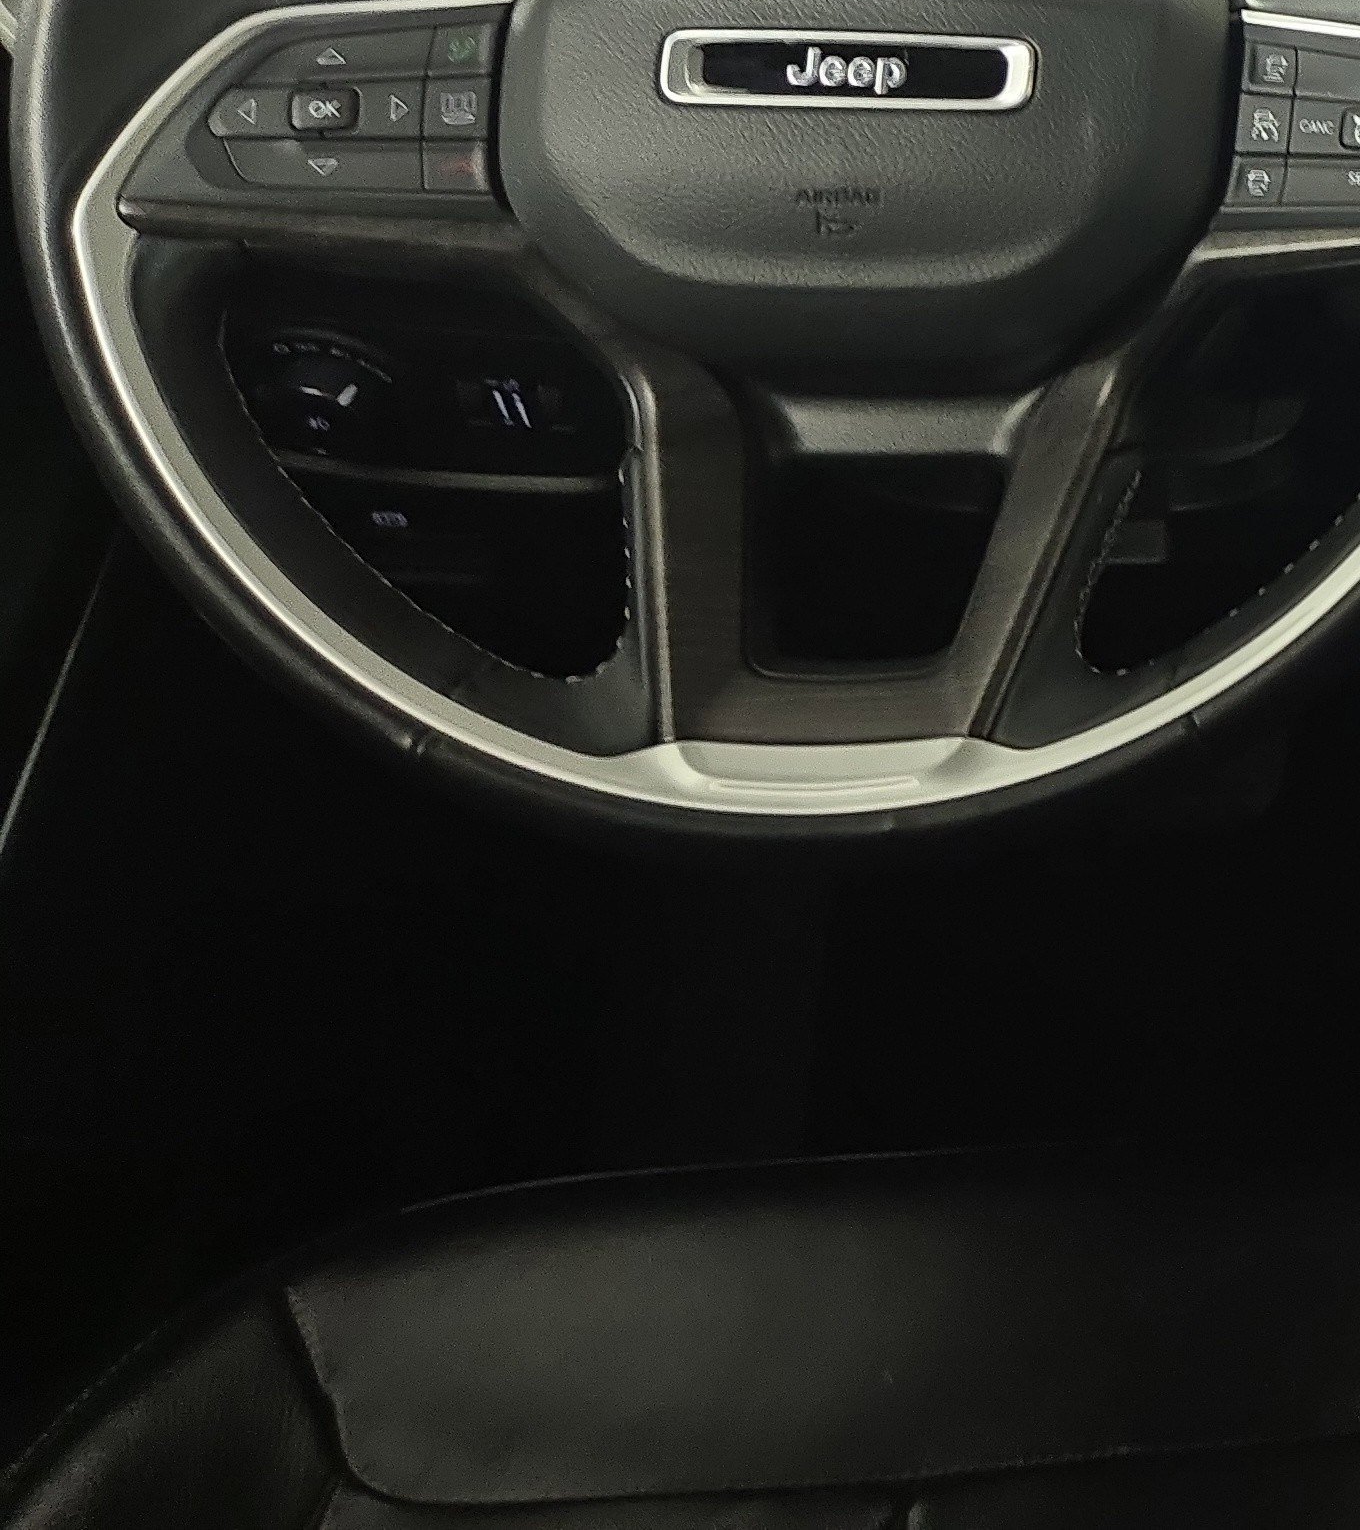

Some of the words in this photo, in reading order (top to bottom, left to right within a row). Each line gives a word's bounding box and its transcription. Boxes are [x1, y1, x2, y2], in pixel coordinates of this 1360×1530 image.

[786, 46, 907, 95] Jeep
[309, 99, 342, 120] OK
[795, 187, 881, 207] AIRBAG
